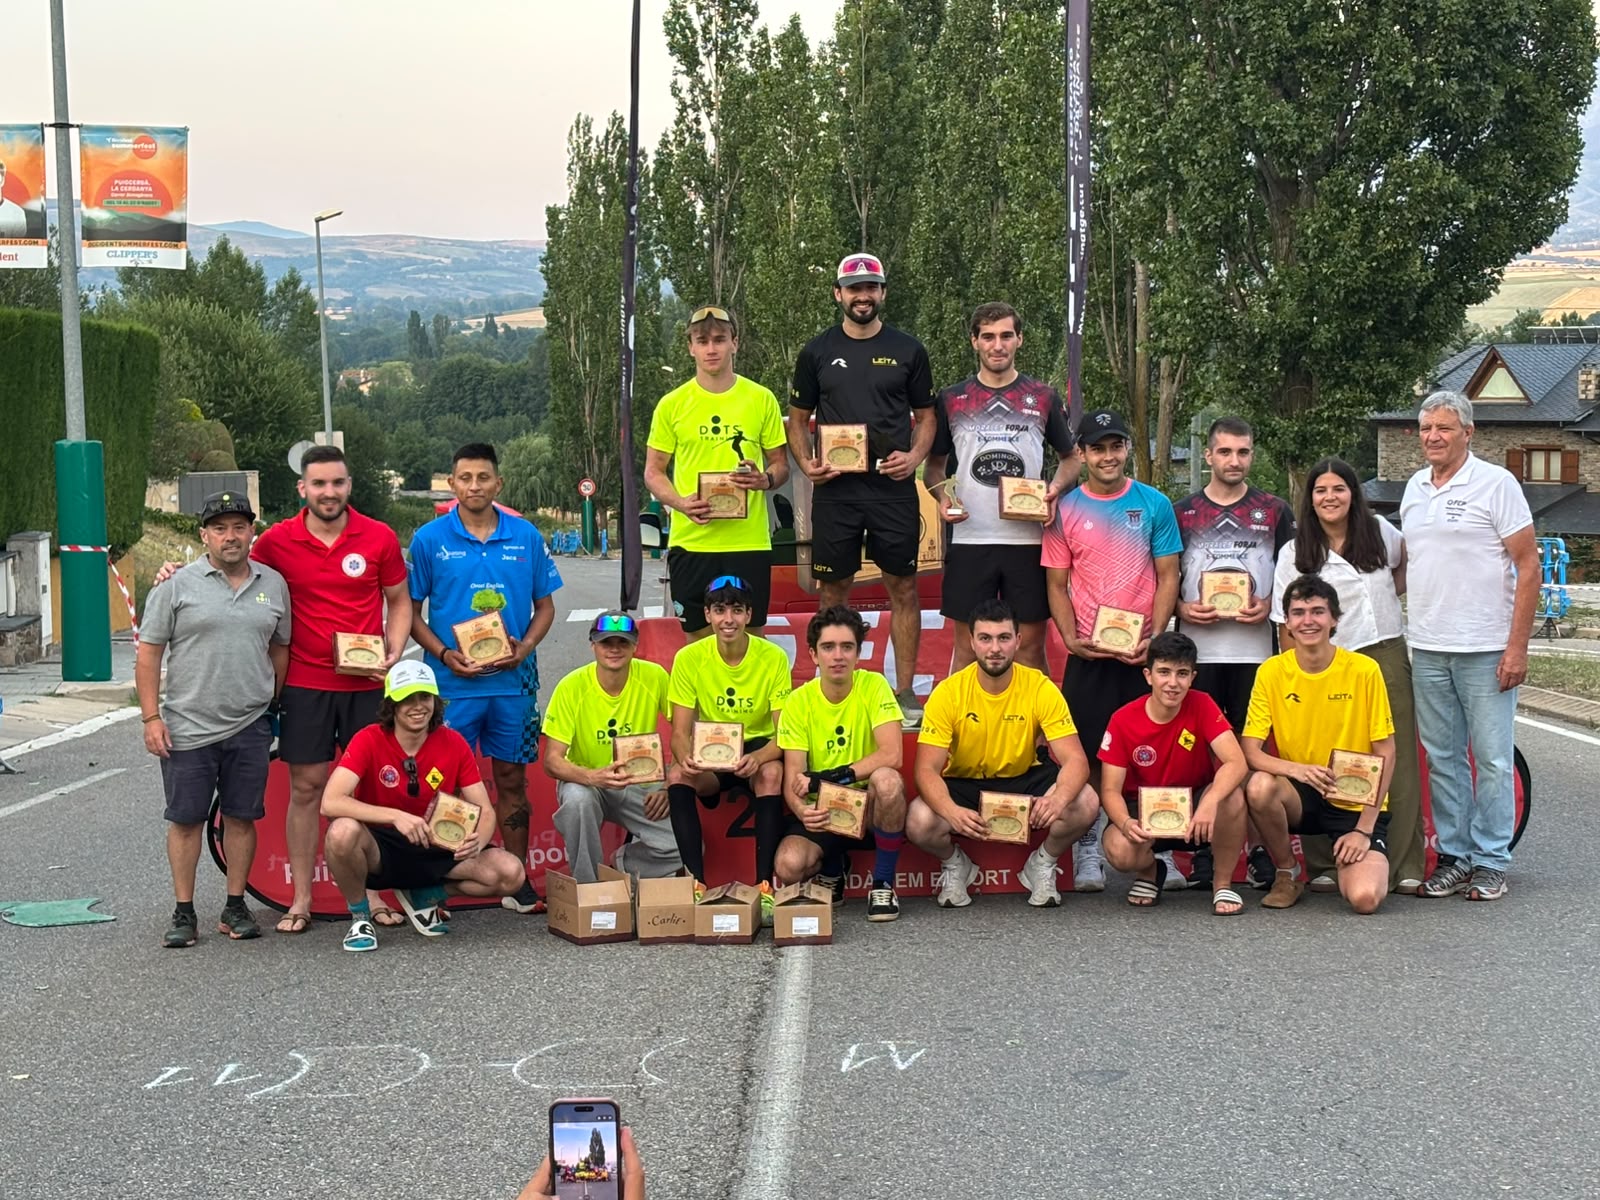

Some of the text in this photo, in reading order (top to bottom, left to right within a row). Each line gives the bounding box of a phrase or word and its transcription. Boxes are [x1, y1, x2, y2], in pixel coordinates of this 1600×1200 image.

[87, 241, 180, 250] OCCIDENTSUMMERFEST.COM
[106, 250, 158, 260] CLIPPER'S
[1005, 424, 1029, 432] FORJA
[979, 453, 1019, 462] DOMINGO
[1233, 541, 1257, 549] FORJA
[895, 872, 924, 888] EM
